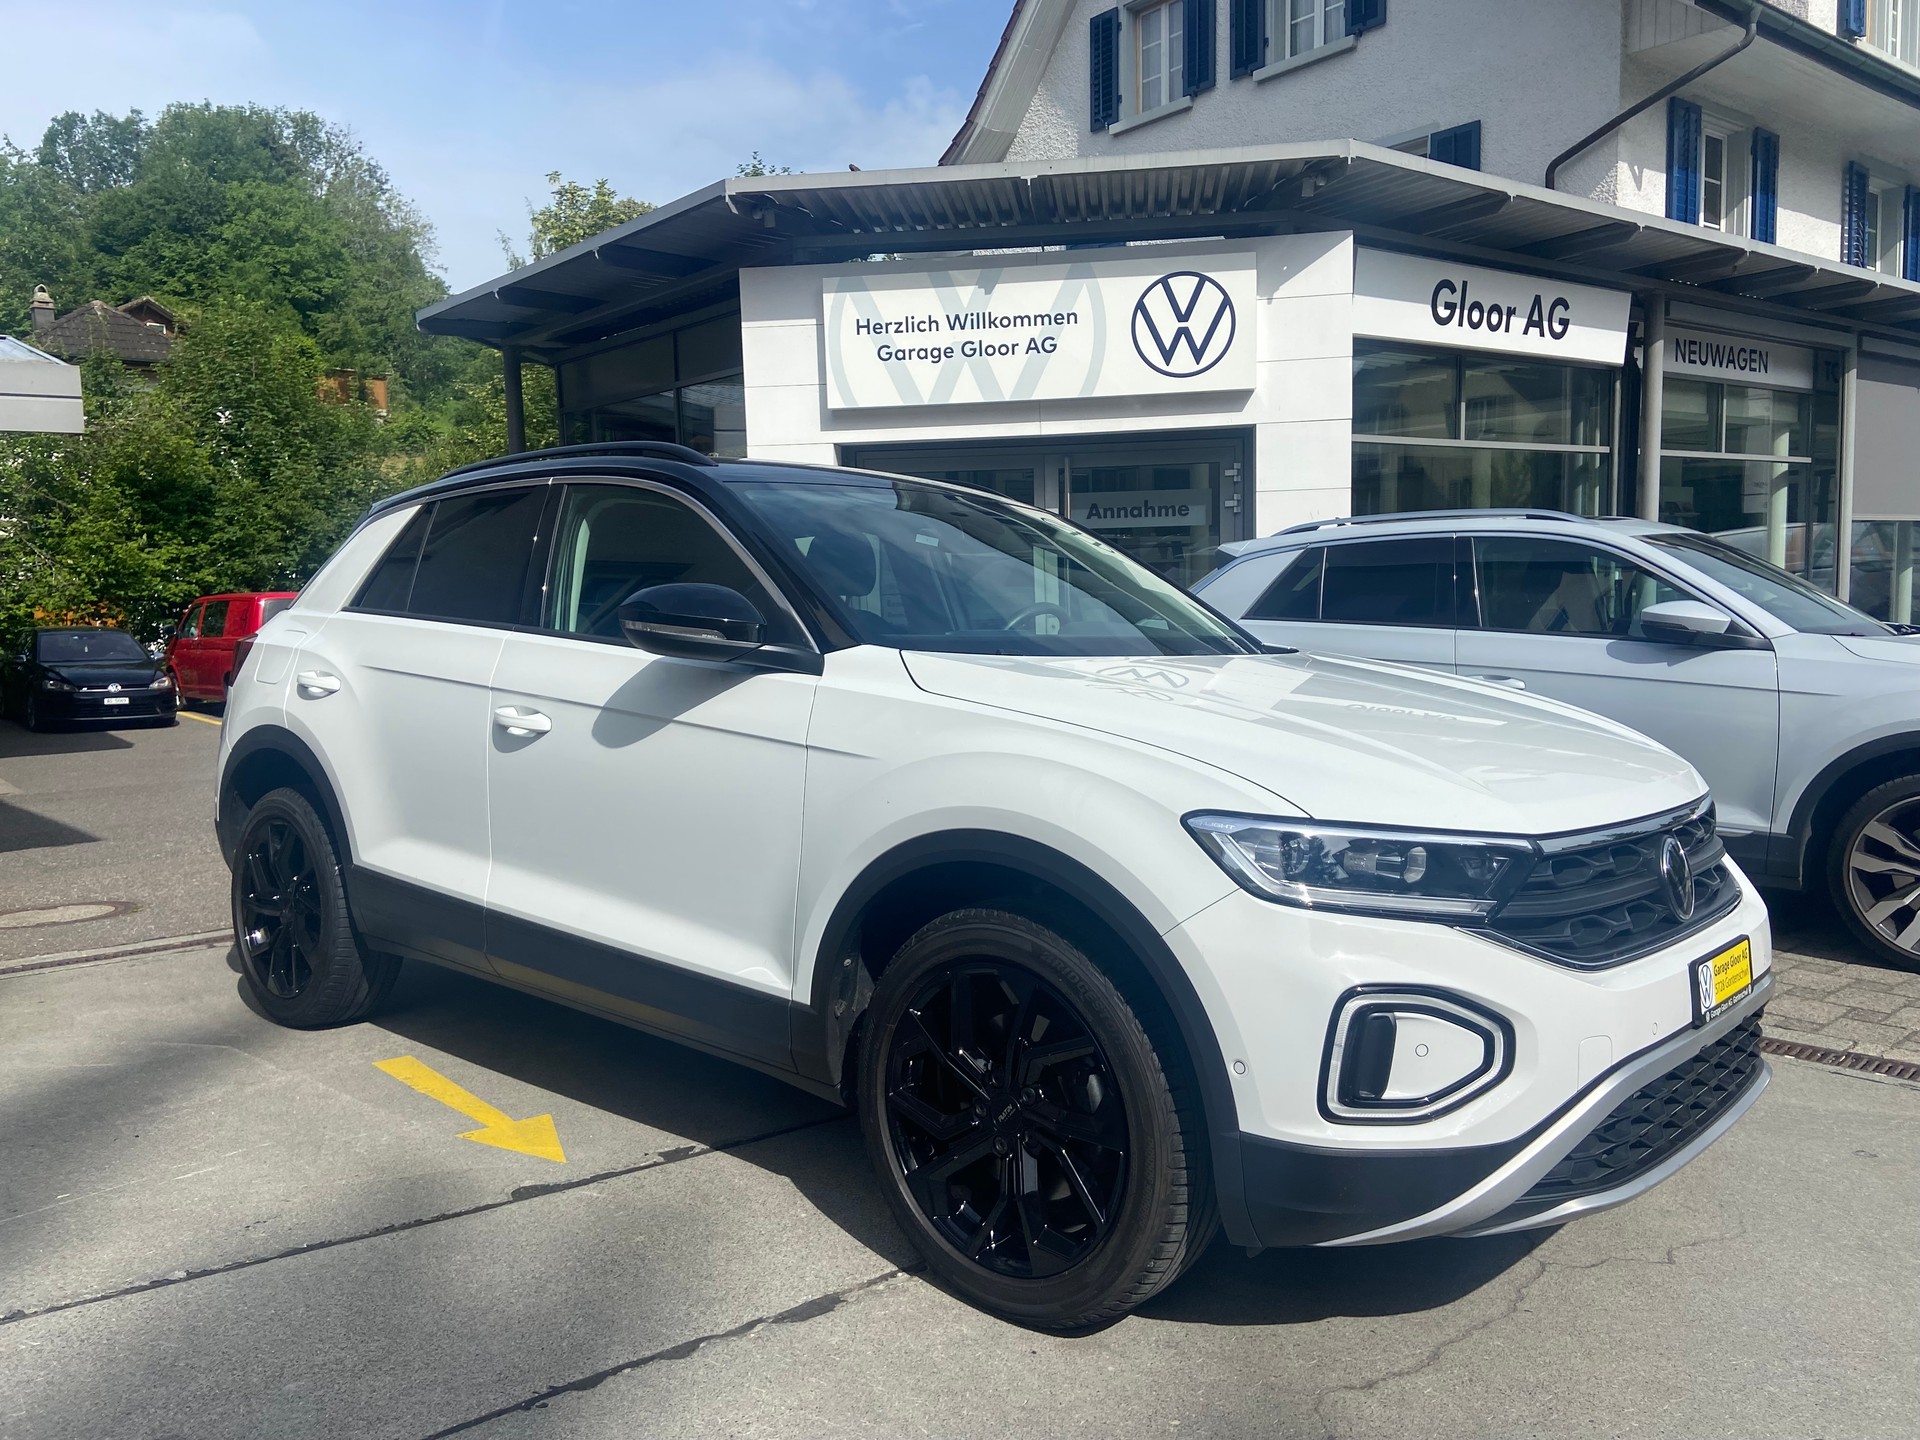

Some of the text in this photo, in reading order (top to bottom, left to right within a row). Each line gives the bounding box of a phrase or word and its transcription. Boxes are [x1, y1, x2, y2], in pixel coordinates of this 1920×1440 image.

[855, 310, 1079, 337] Herzlich Willkommen
[1431, 278, 1571, 341] Gloor AG
[877, 336, 1059, 364] Garage Gloor AG
[1675, 337, 1769, 374] NEUWAGEN
[1086, 500, 1190, 520] Annahme
[1713, 947, 1748, 977] Garage Gloor AG
[1715, 979, 1725, 995] 5728
